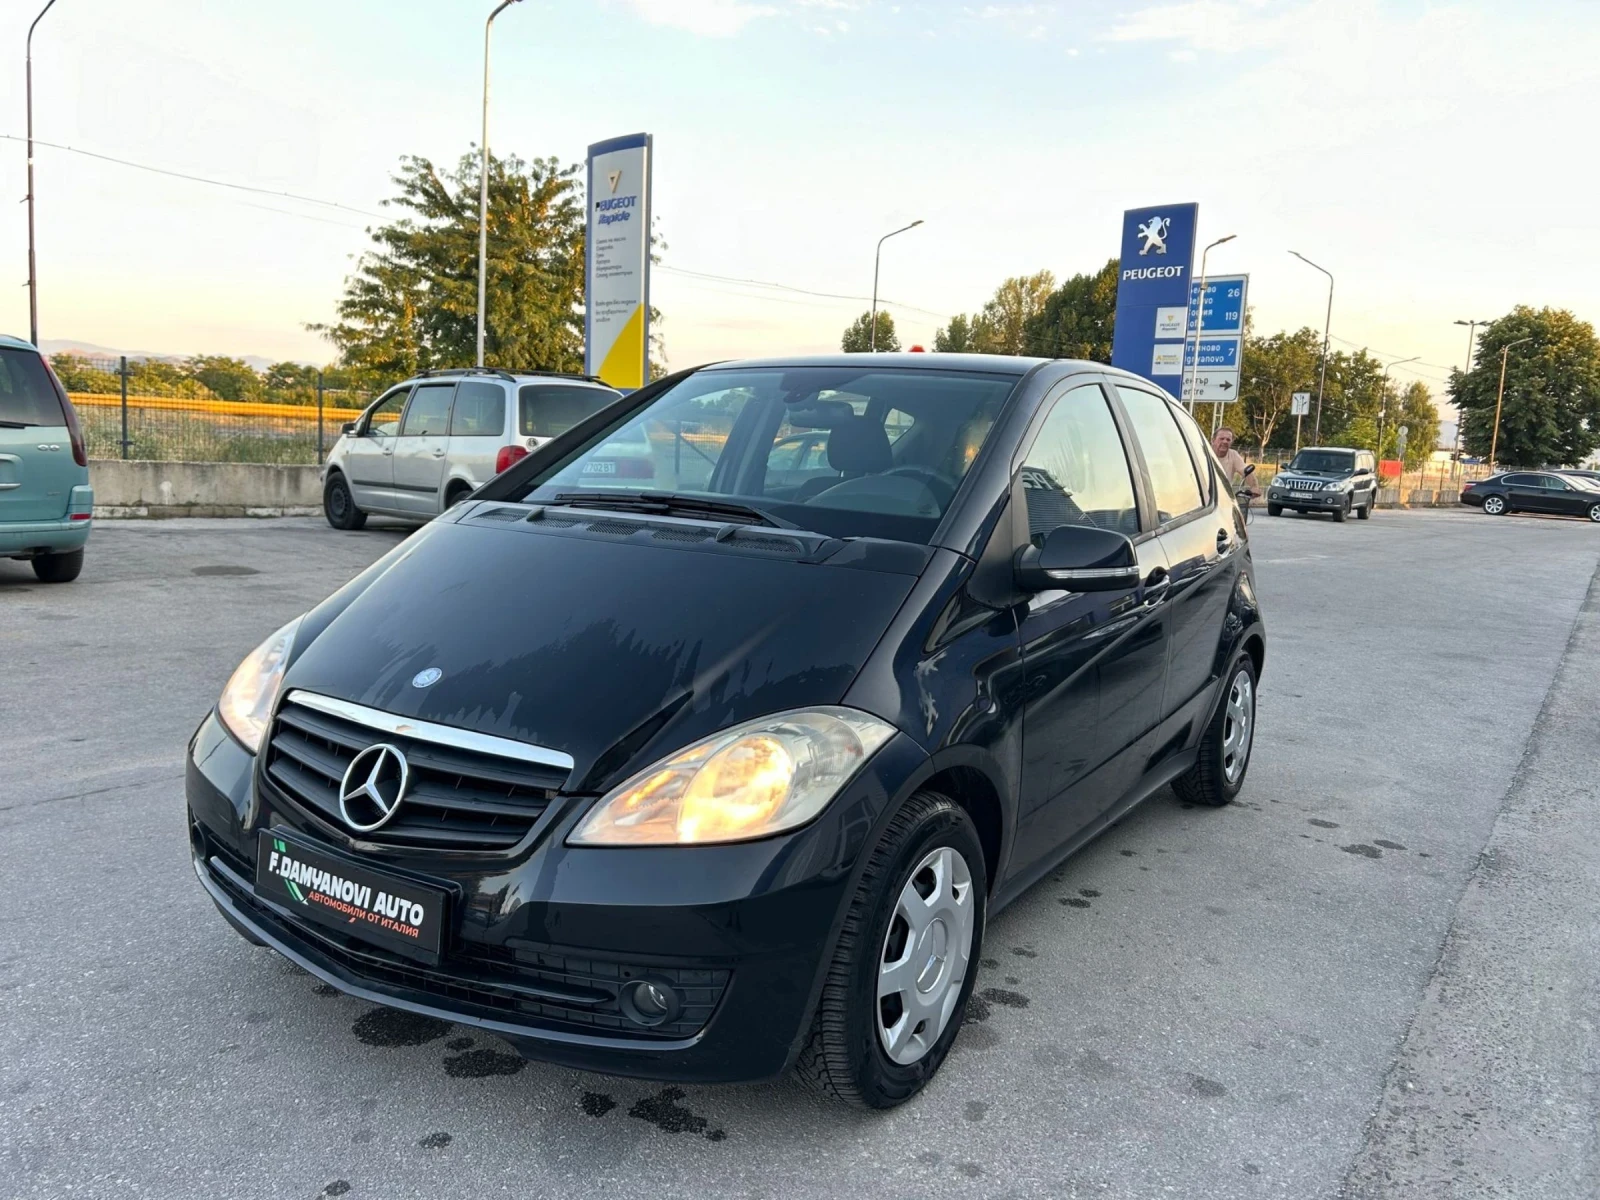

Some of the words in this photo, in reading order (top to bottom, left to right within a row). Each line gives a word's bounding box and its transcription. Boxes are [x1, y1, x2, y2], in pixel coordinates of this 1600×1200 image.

[1122, 265, 1184, 281] PEUGEOT
[1227, 288, 1240, 298] 26
[1225, 311, 1238, 321] 119
[1228, 347, 1235, 357] 7
[268, 851, 372, 909] F.DAMYANOVI
[372, 891, 424, 926] AUTO
[308, 890, 366, 920] АВТОМОБИЛИ
[367, 912, 381, 925] ОТ
[381, 916, 419, 939] ИТАЛИЯ
